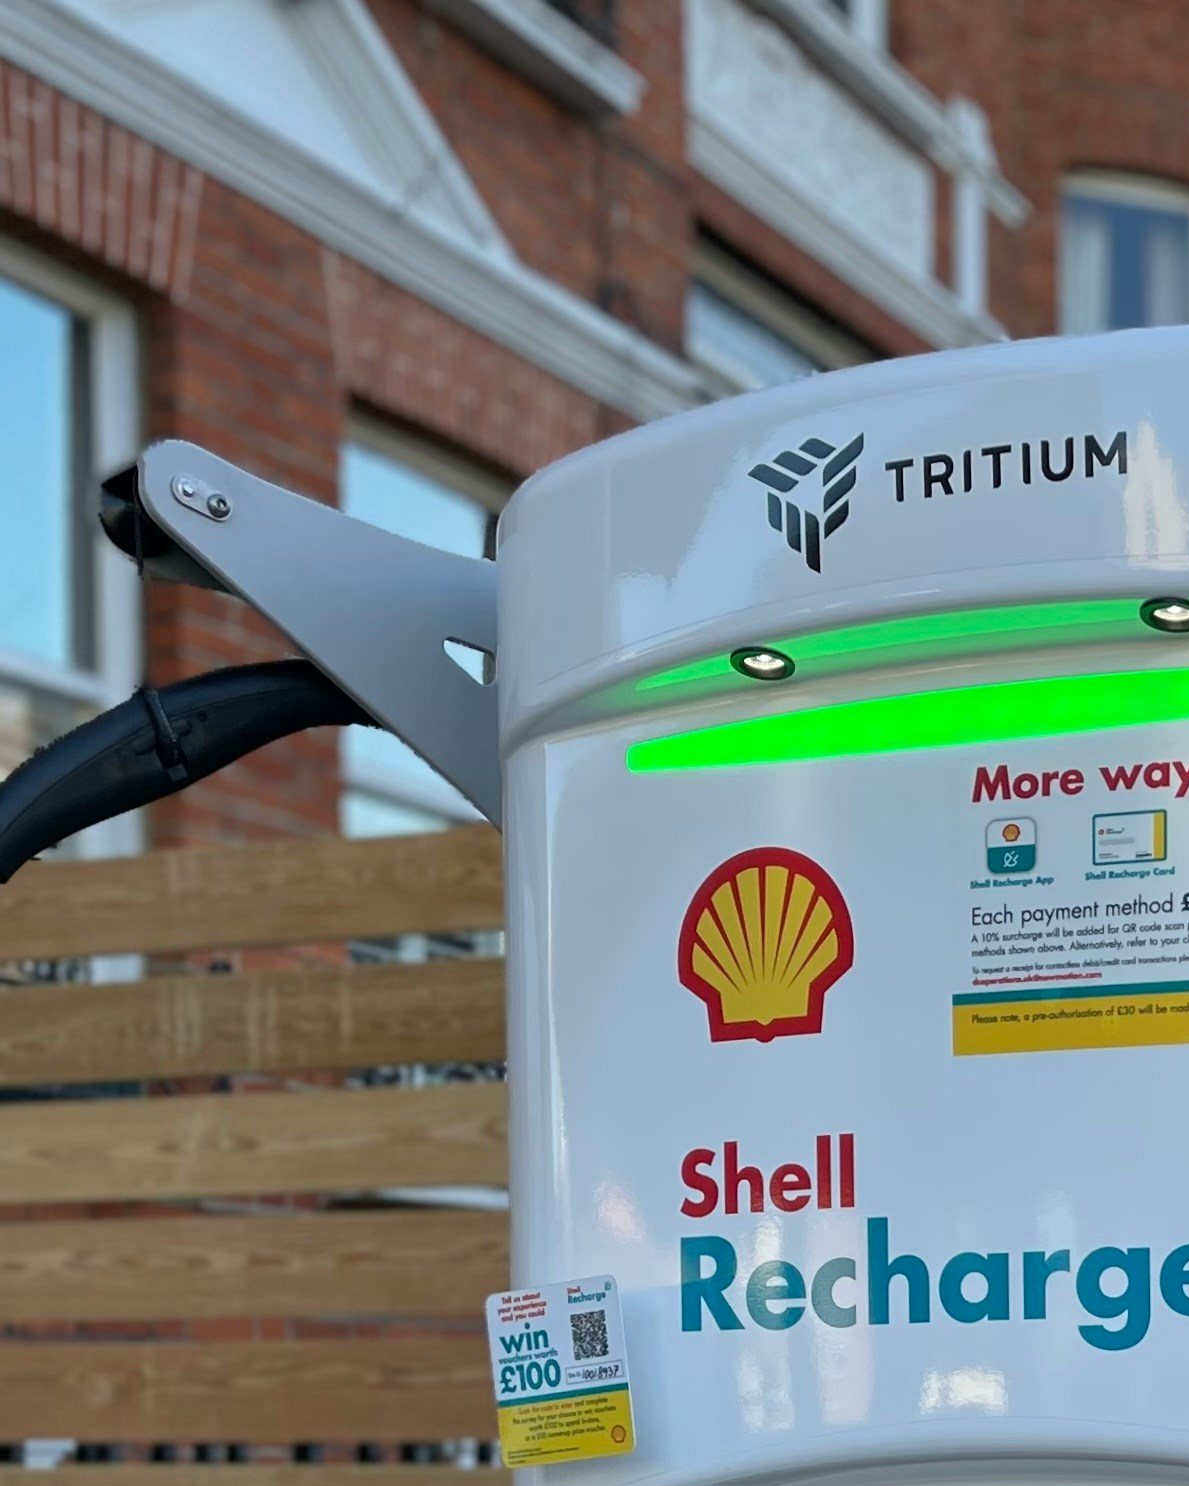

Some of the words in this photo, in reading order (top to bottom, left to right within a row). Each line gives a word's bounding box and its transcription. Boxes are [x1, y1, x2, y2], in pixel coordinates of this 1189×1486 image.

[885, 431, 1127, 502] TRITIUM
[971, 765, 1084, 802] More
[1036, 876, 1054, 885] App
[1153, 866, 1175, 875] Card
[971, 904, 1013, 926] Each
[1021, 901, 1099, 928] payment
[1105, 893, 1174, 916] method
[971, 934, 979, 943] A
[981, 932, 999, 942] 10%
[1002, 931, 1043, 943] surcharge
[1045, 928, 1060, 938] will
[1062, 927, 1074, 937] be
[1076, 926, 1105, 936] added
[1107, 924, 1119, 935] for
[1122, 923, 1137, 934] QR
[1139, 922, 1162, 932] code
[1164, 922, 1185, 931] scan
[971, 946, 1006, 957] methods
[1008, 945, 1036, 955] shown
[1038, 943, 1066, 953] above.
[1069, 939, 1124, 952] Alternatively,
[1126, 937, 1146, 947] refer
[1149, 937, 1158, 946] to
[1160, 937, 1180, 948] your
[971, 1014, 998, 1024] Please
[1032, 1009, 1103, 1022] pre-authorisation
[1105, 1006, 1115, 1016] of
[1117, 1005, 1136, 1015] £30
[1138, 1004, 1153, 1014] will
[1155, 1003, 1168, 1014] be
[680, 1133, 855, 1218] Shell
[568, 1292, 606, 1304] Recharge
[499, 1322, 549, 1354] win
[500, 1359, 561, 1394] £100
